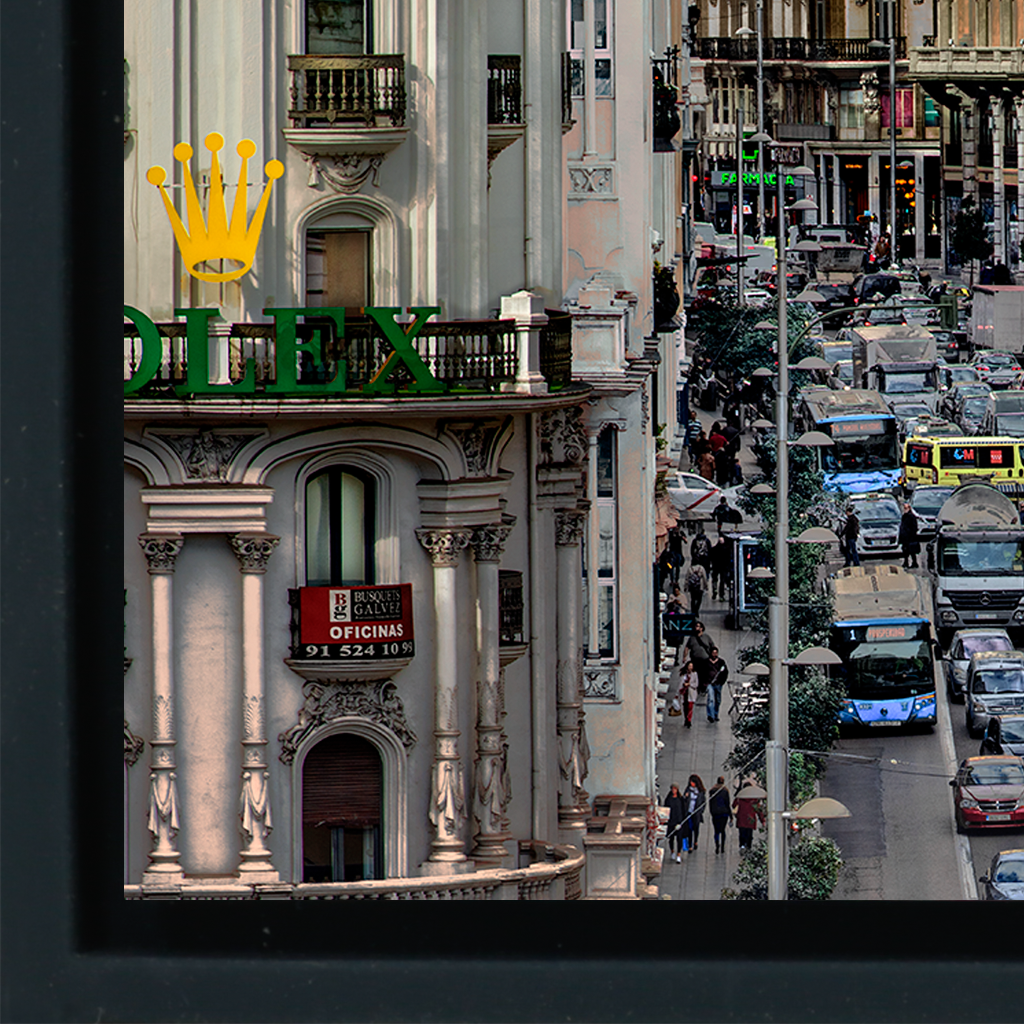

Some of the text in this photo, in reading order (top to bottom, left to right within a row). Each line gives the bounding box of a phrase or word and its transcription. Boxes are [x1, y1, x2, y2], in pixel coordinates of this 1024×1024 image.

[721, 173, 795, 186] FARMACA
[354, 590, 400, 603] BUSQUETS
[353, 602, 400, 615] GALVEZ
[329, 623, 404, 640] OFICINAS
[305, 644, 331, 657] 91
[339, 644, 375, 657] 524
[382, 643, 399, 655] 10
